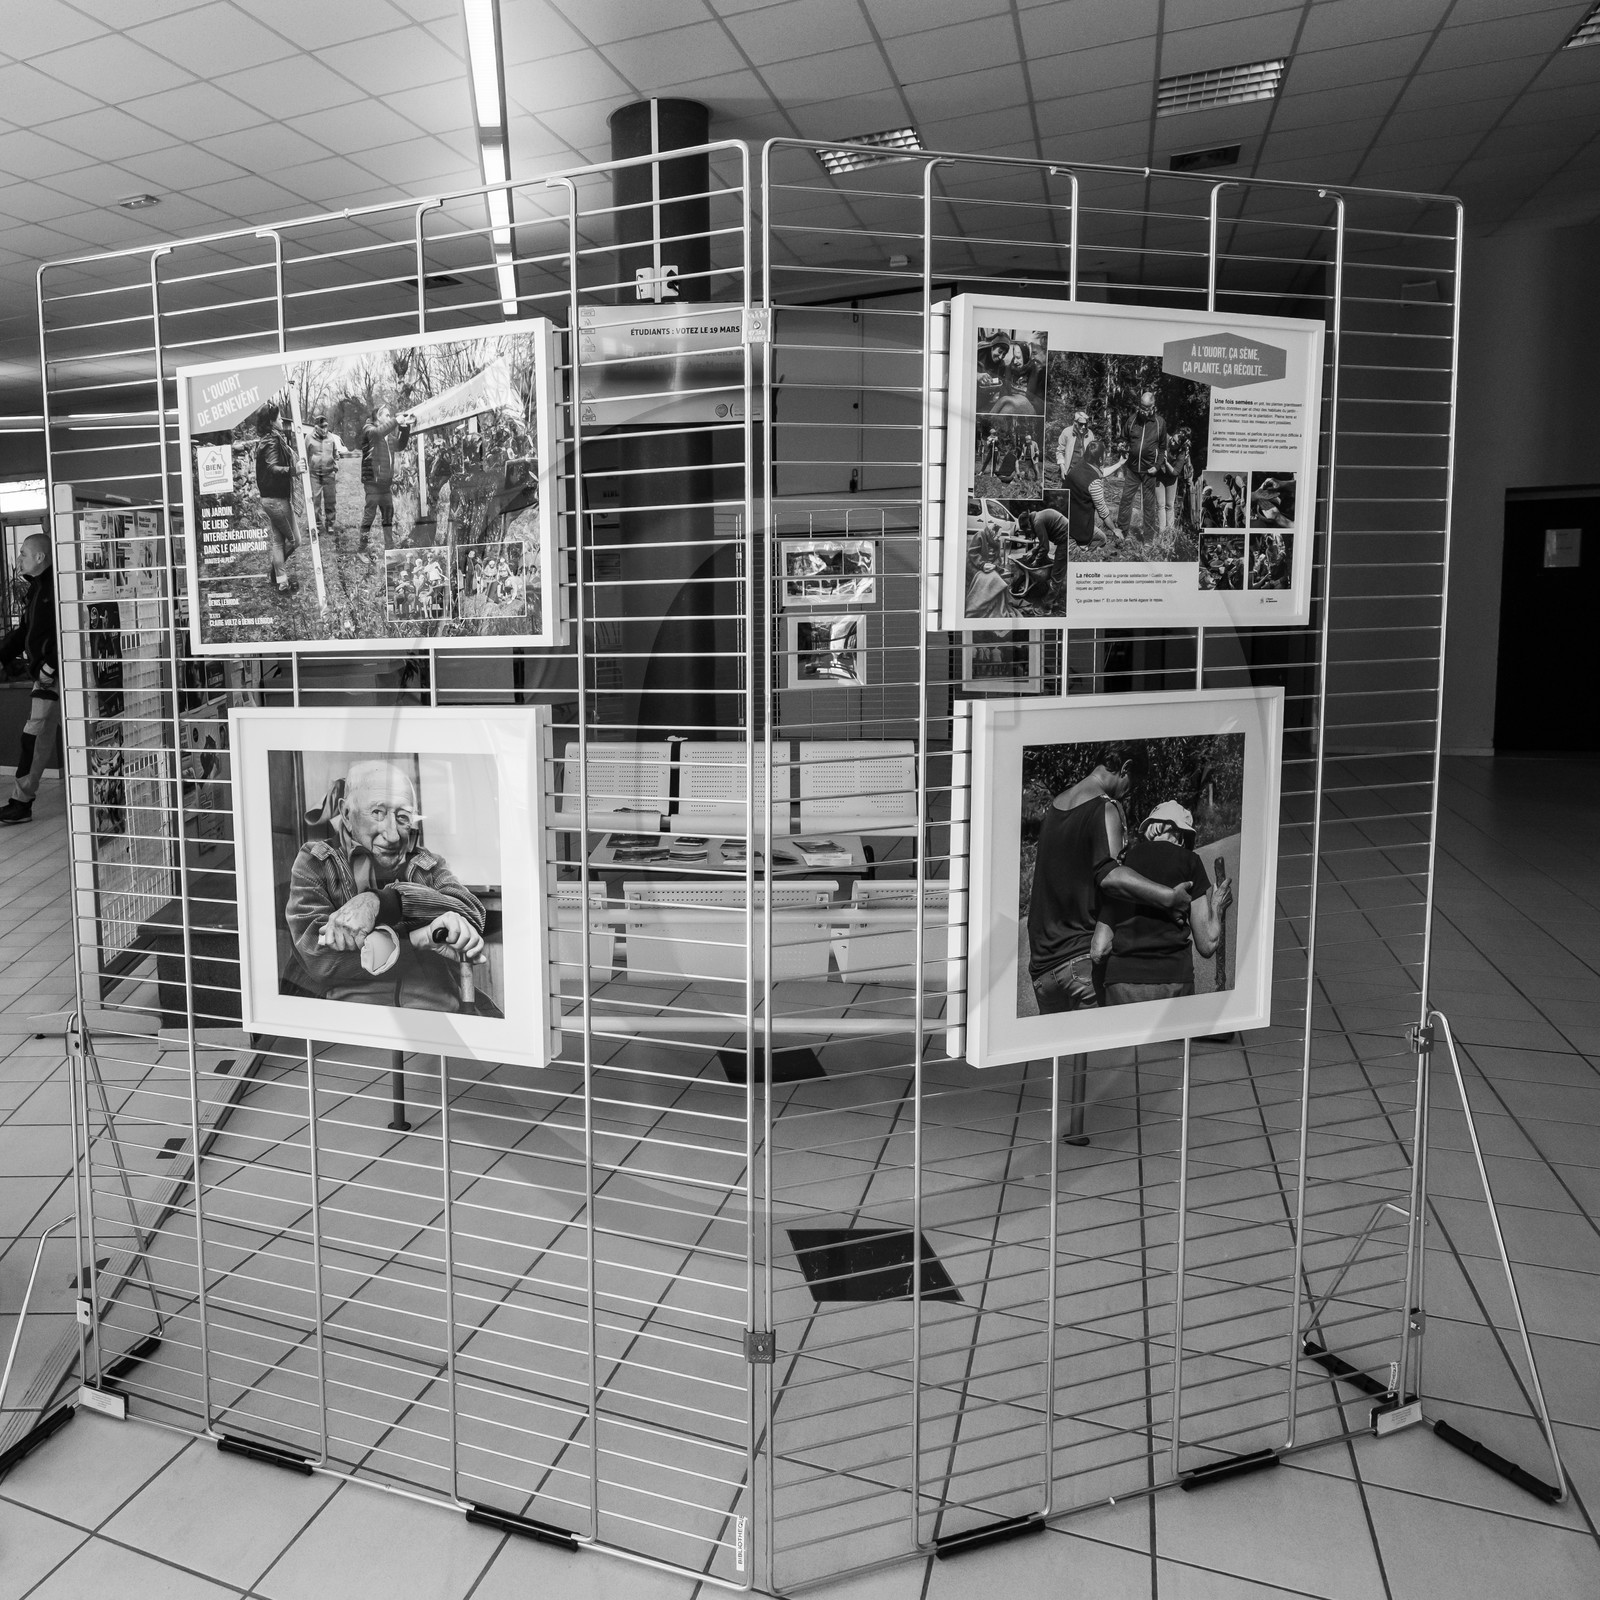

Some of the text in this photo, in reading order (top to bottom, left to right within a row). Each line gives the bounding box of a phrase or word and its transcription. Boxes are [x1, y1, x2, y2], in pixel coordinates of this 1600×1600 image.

[1191, 344, 1196, 356] À
[1229, 347, 1237, 360] ÇA
[1240, 346, 1259, 360] SÈME,
[1183, 362, 1192, 374] ÇA
[1194, 362, 1221, 375] PLANTE,
[1223, 364, 1232, 376] ÇA
[202, 373, 241, 403] L'OUORT
[197, 409, 211, 427] DE
[202, 506, 232, 518] UN JARDIN
[202, 519, 228, 530] DE LIENS
[204, 541, 267, 554] DANS LE CHAMPSAUR
